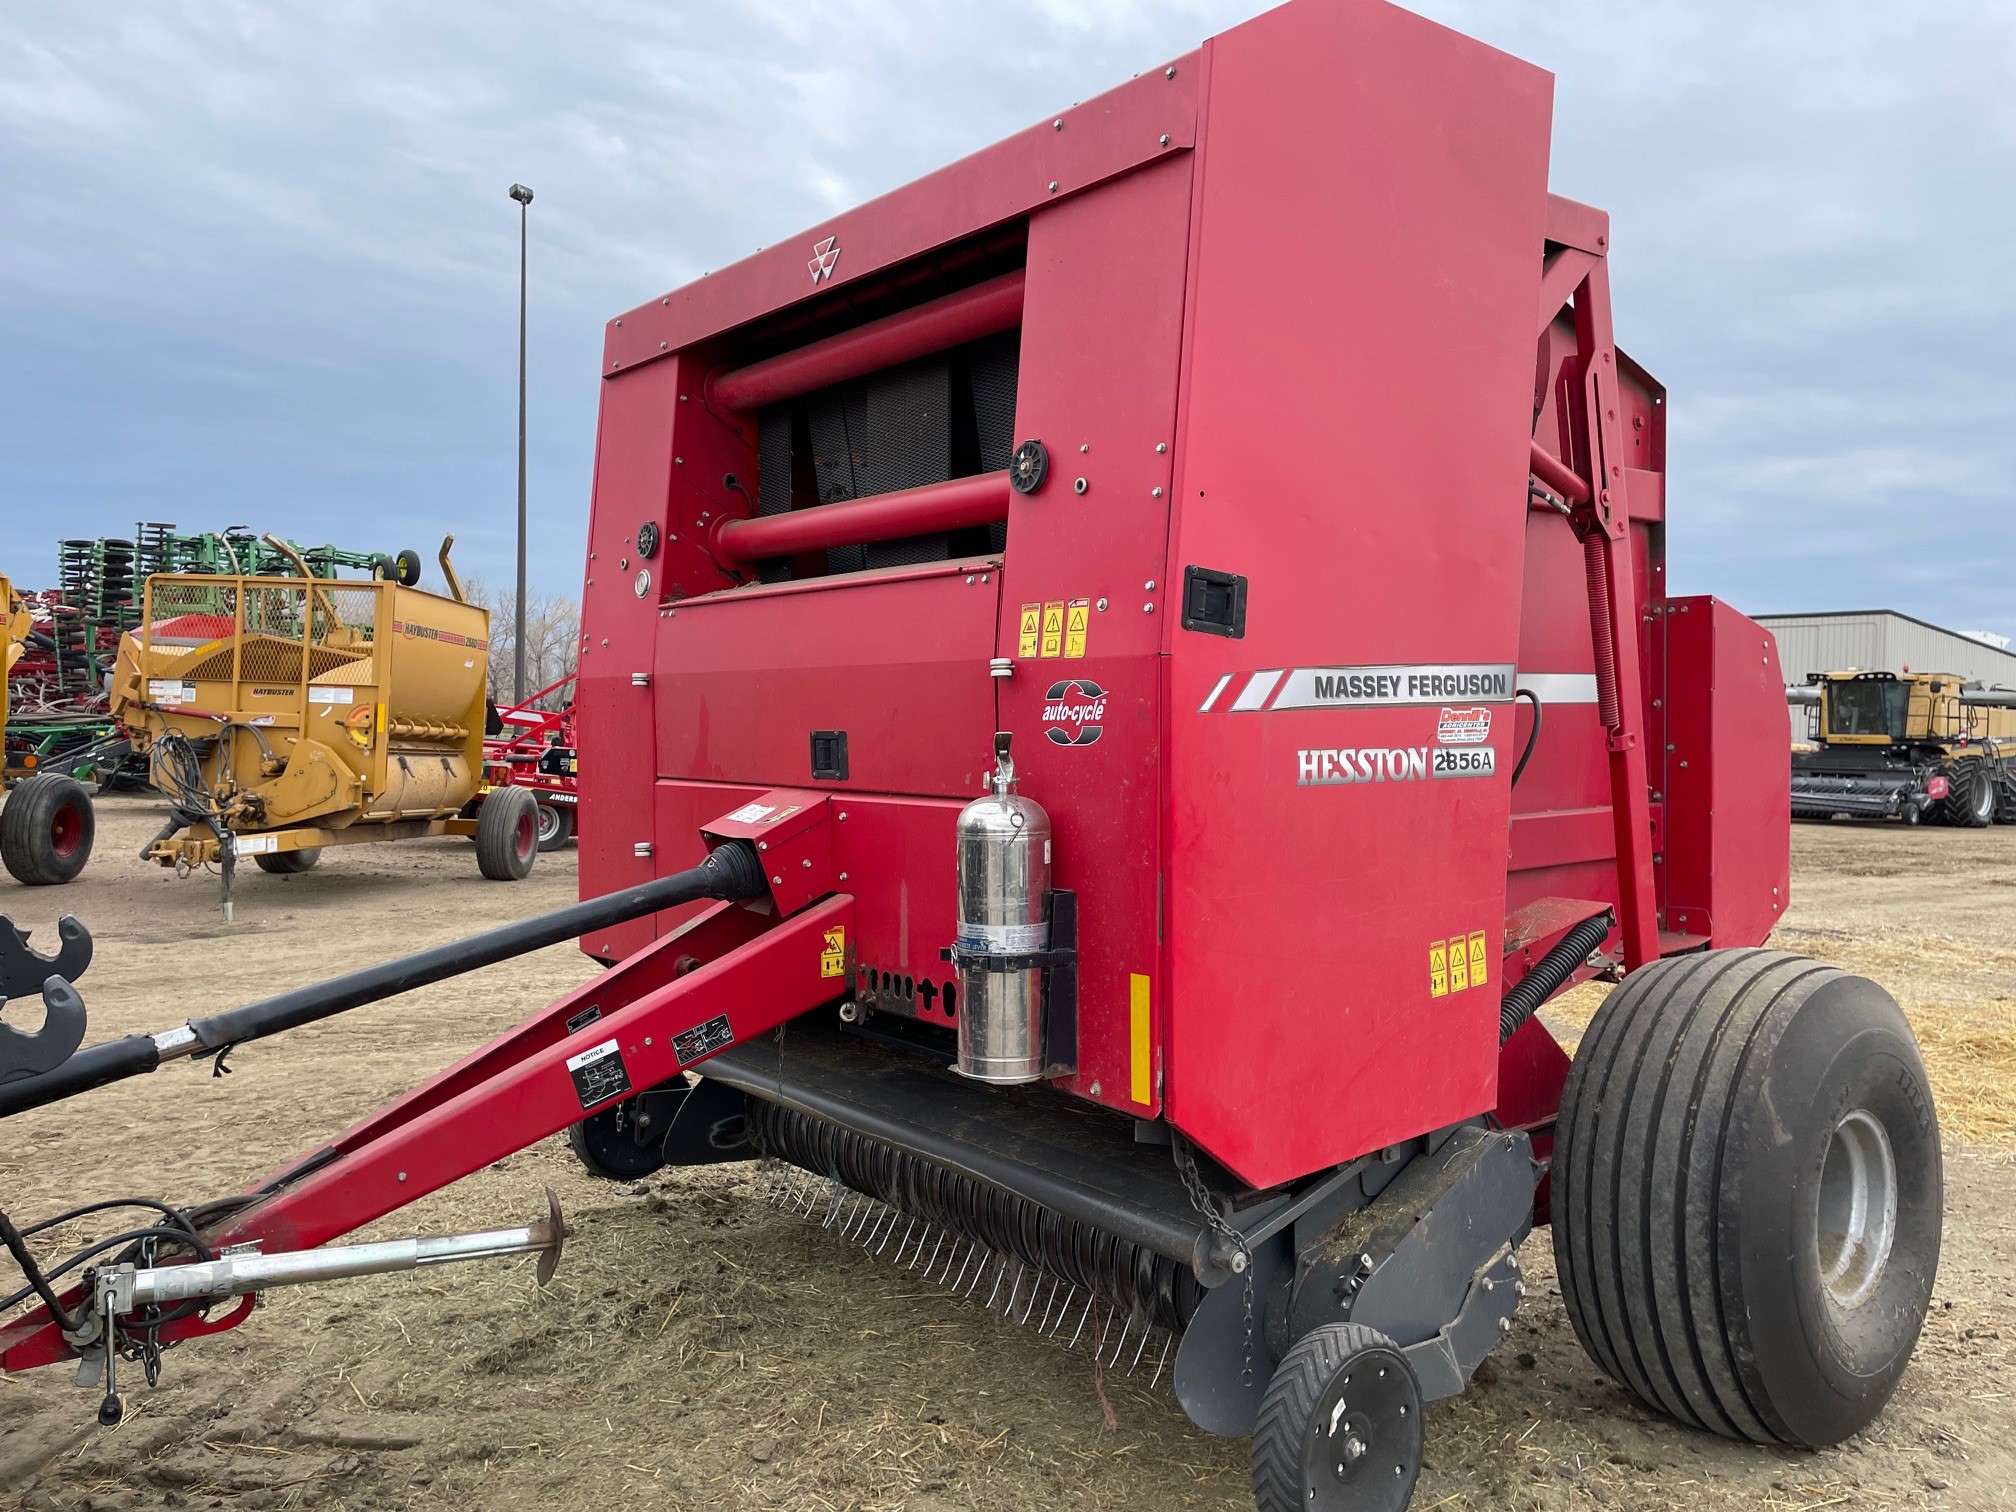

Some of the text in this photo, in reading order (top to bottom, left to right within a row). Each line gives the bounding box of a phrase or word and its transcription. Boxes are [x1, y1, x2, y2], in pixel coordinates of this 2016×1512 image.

[404, 623, 439, 640] HAYBUSTER
[252, 688, 295, 696] HAYBUSTER
[1314, 673, 1506, 699] MASSEY FERGUSON
[1042, 699, 1104, 726] auto-cycle
[1297, 746, 1428, 786] HESSTON
[1434, 752, 1492, 772] 2856A
[580, 1047, 605, 1062] NOTICE
